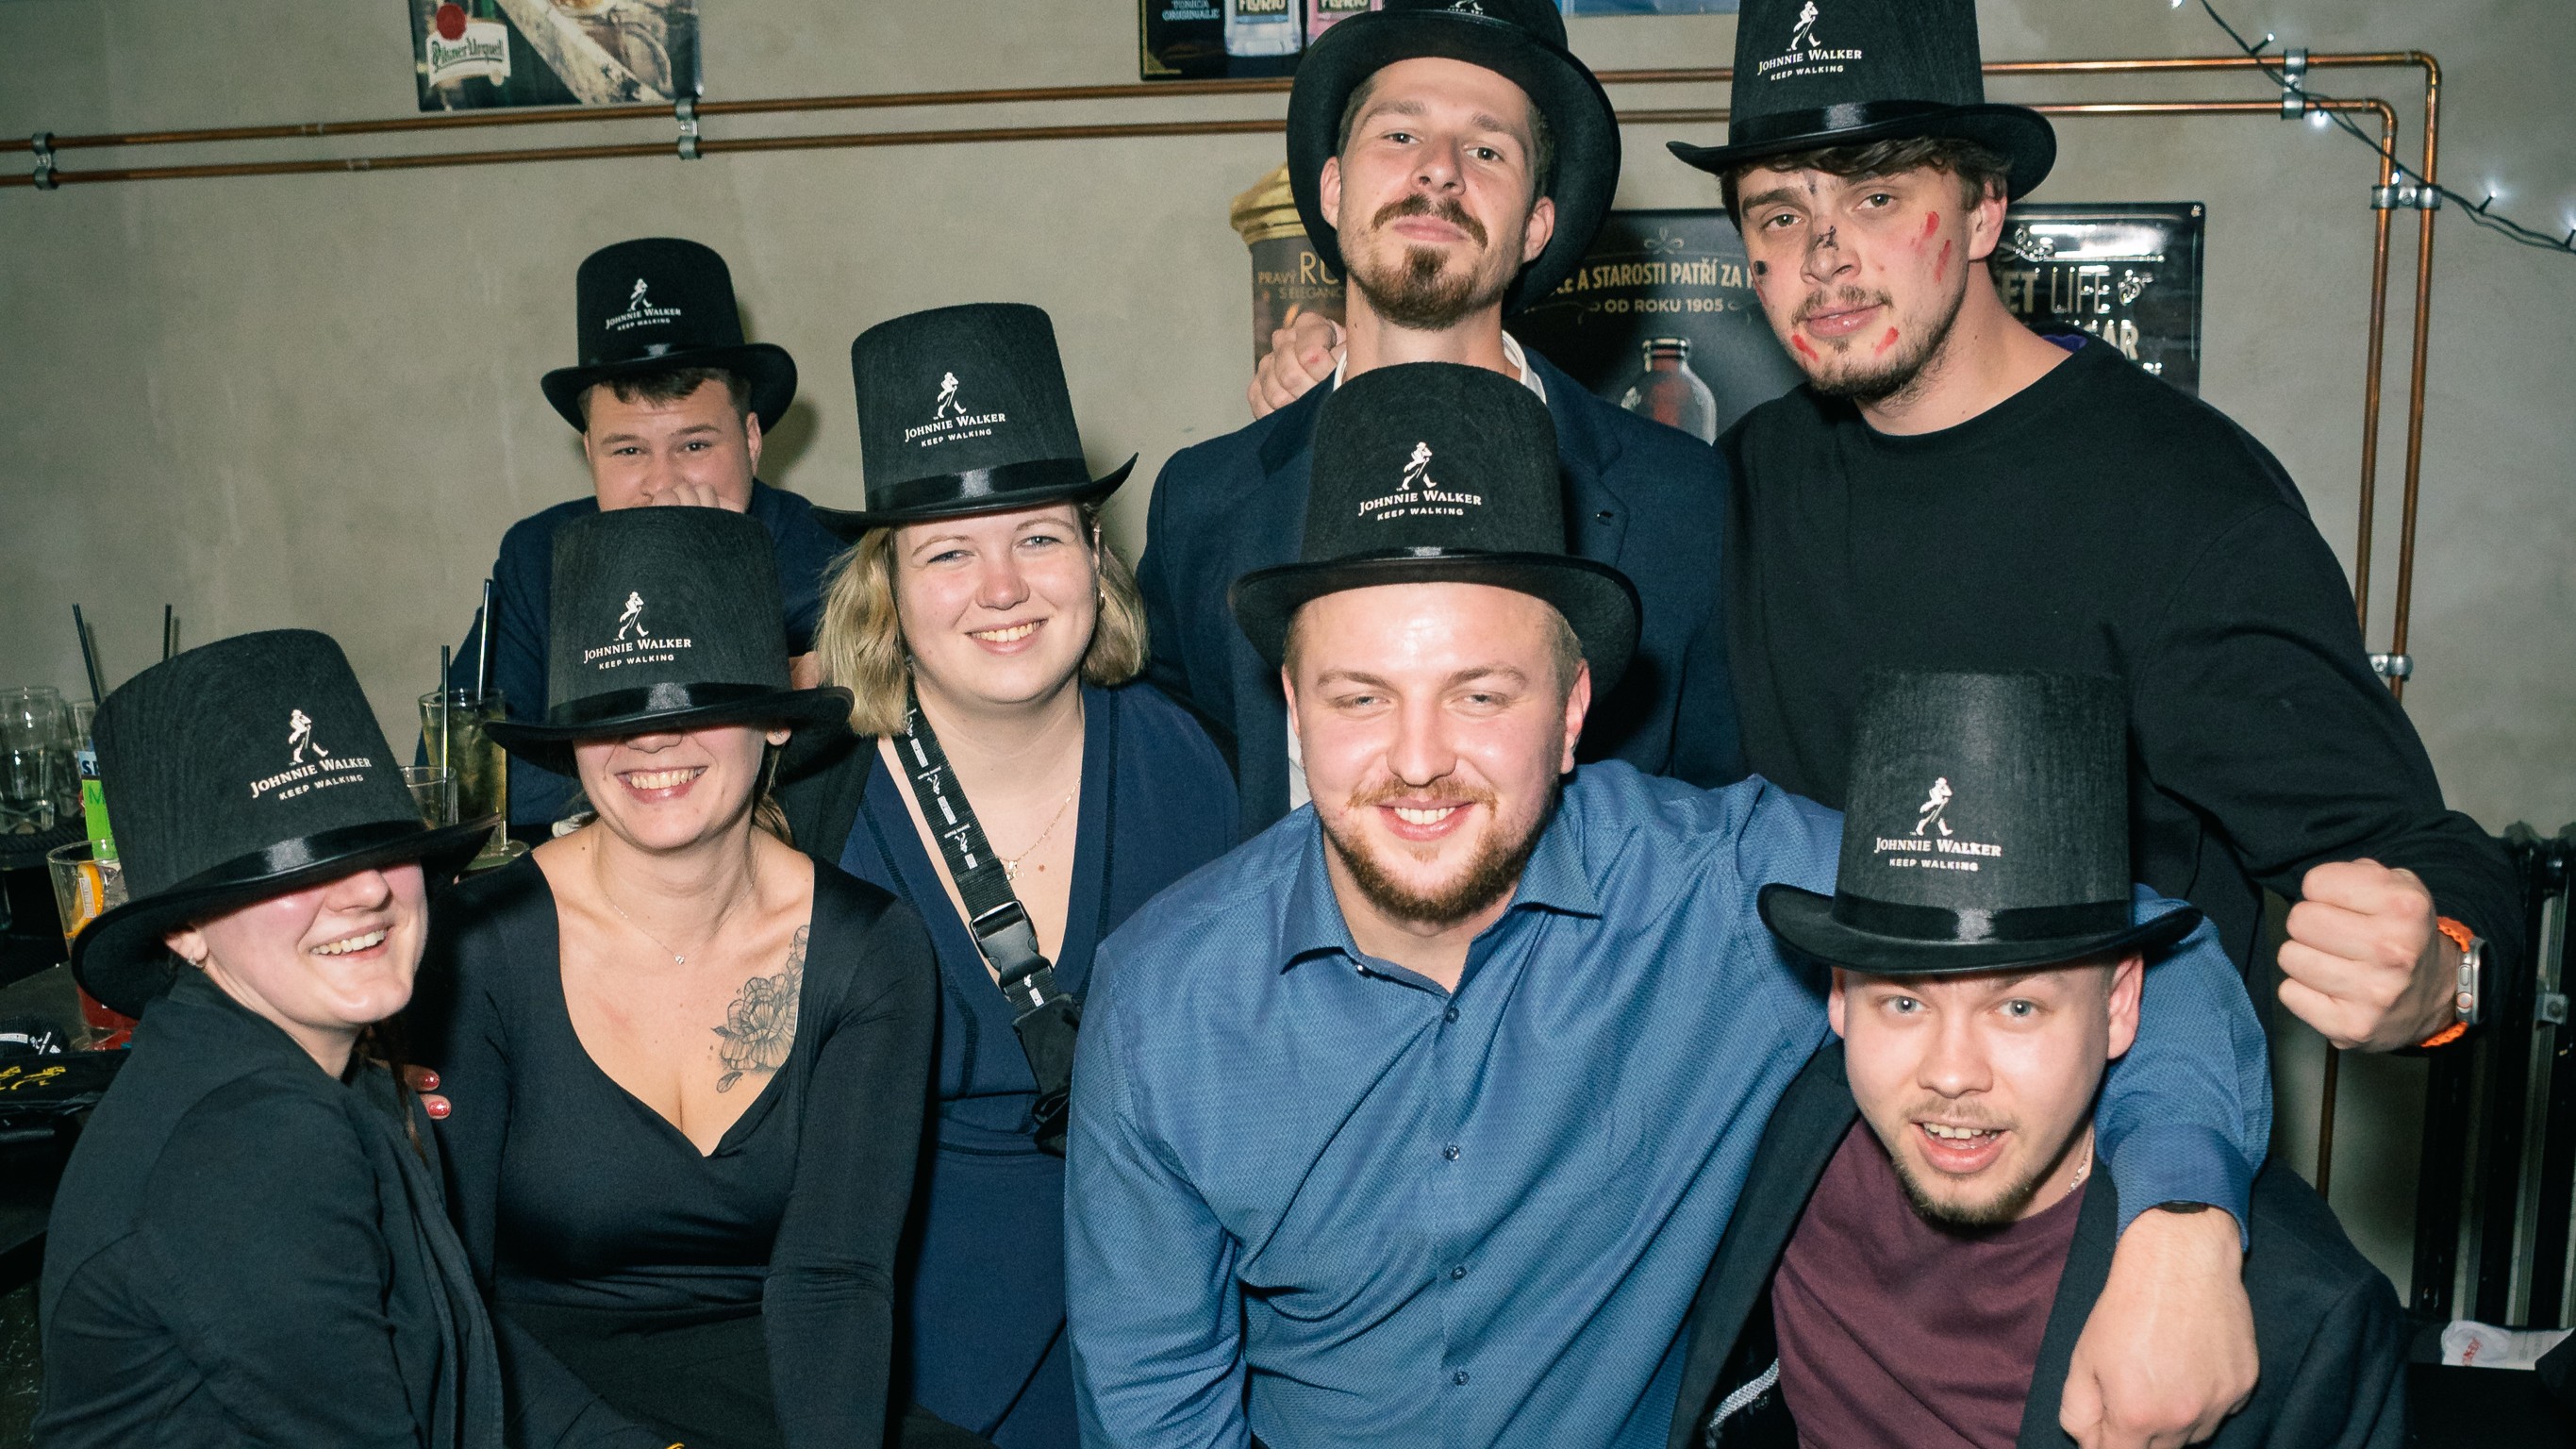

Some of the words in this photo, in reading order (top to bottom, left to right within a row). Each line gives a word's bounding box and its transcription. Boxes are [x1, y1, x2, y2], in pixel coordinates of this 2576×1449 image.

[1757, 52, 1803, 76] JOHNNIE
[1808, 48, 1863, 61] WALKER
[1770, 69, 1793, 82] KEEP
[1796, 64, 1844, 75] WALKING
[1577, 269, 1590, 291] A
[1592, 261, 1667, 290] STAROSTI
[1670, 257, 1718, 287] PATŘÍ
[1720, 264, 1743, 289] ZA
[2050, 265, 2112, 315] LIFE
[1604, 300, 1630, 313] OD
[1634, 298, 1682, 313] ROKU
[1686, 298, 1724, 312] 1905
[605, 310, 642, 330] JOHNNIE
[643, 308, 682, 316] WALKER
[905, 420, 954, 442] JOHNNIE
[956, 413, 1006, 427] WALKER
[921, 436, 944, 448] KEEP
[947, 428, 992, 441] WALKING
[1358, 492, 1419, 517] JOHNNIE
[1422, 490, 1482, 506] WALKER
[1377, 508, 1405, 521] KEEP
[1410, 507, 1464, 516] WALKING
[583, 642, 634, 664] JOHNNIE
[637, 638, 691, 650] WALKER
[599, 659, 623, 670] KEEP
[626, 654, 674, 665] WALKING
[249, 764, 318, 799] JOHNNIE
[319, 758, 373, 772] WALKER
[278, 784, 310, 801] KEEP
[313, 774, 364, 789] WALKING
[1873, 837, 1932, 854] JOHNNIE
[1936, 839, 2002, 858] WALKER
[1888, 858, 1918, 867] KEEP
[1920, 858, 1979, 873] WALKING
